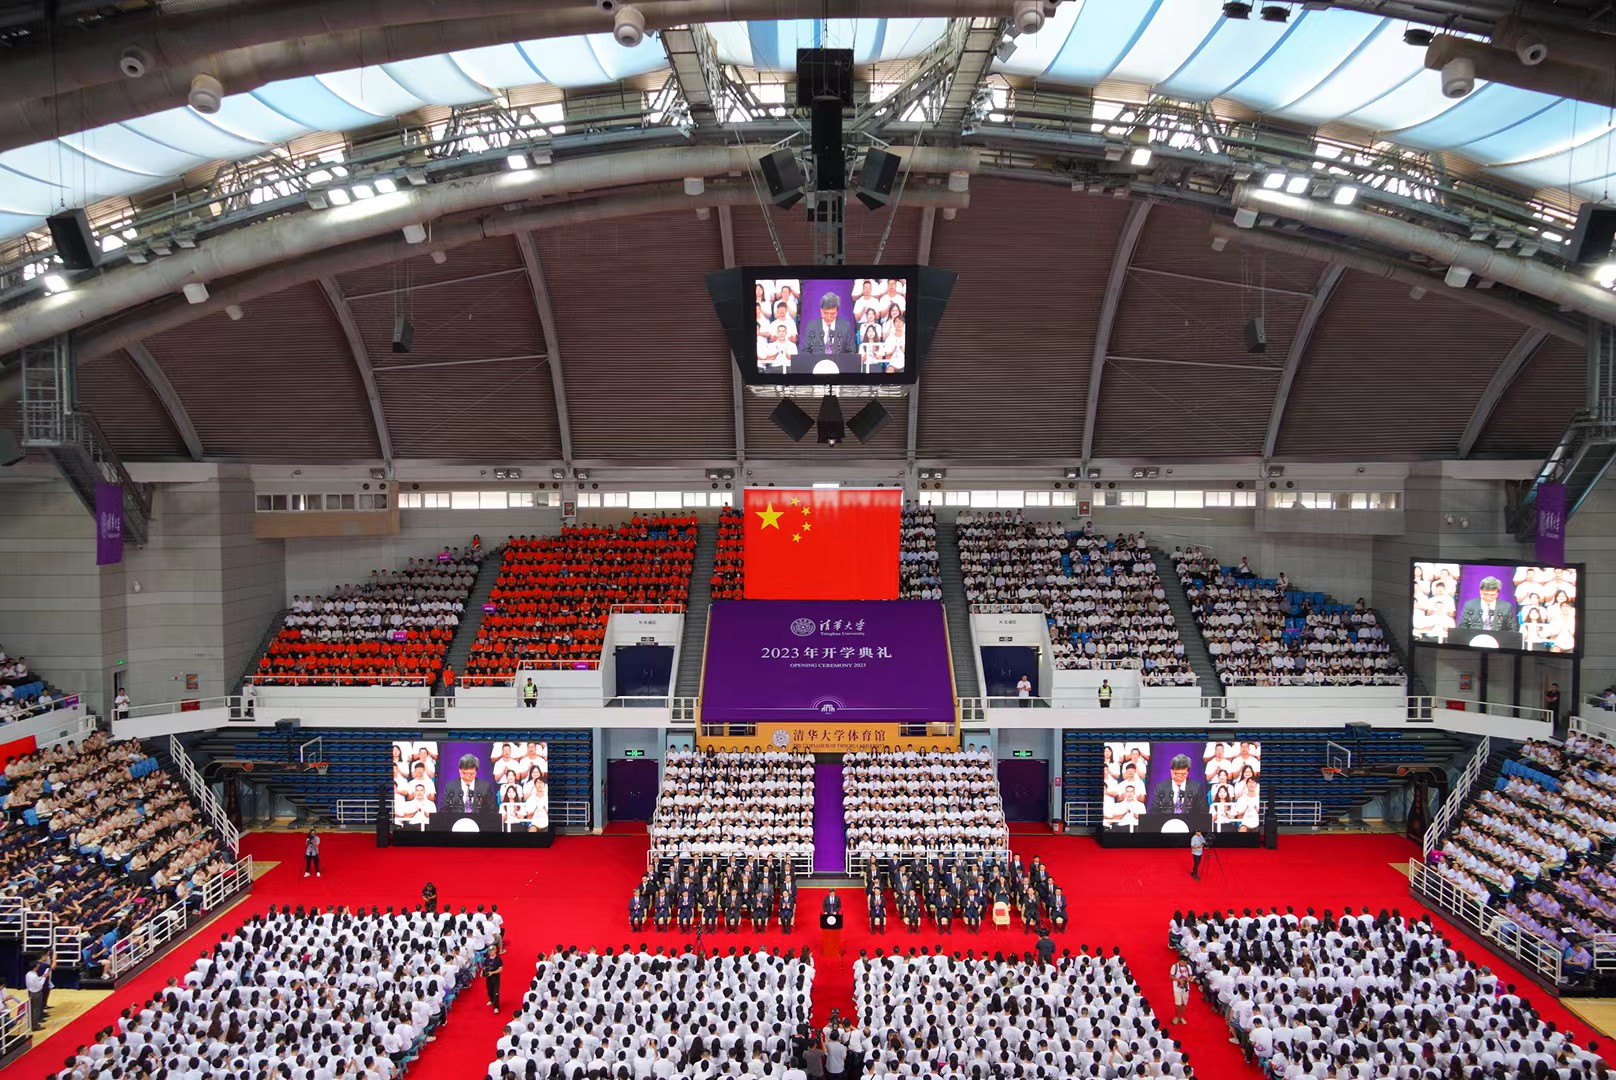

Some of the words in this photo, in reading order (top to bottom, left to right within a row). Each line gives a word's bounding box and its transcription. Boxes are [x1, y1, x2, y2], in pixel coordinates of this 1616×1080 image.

[793, 729, 886, 742] 清华大学体育馆
